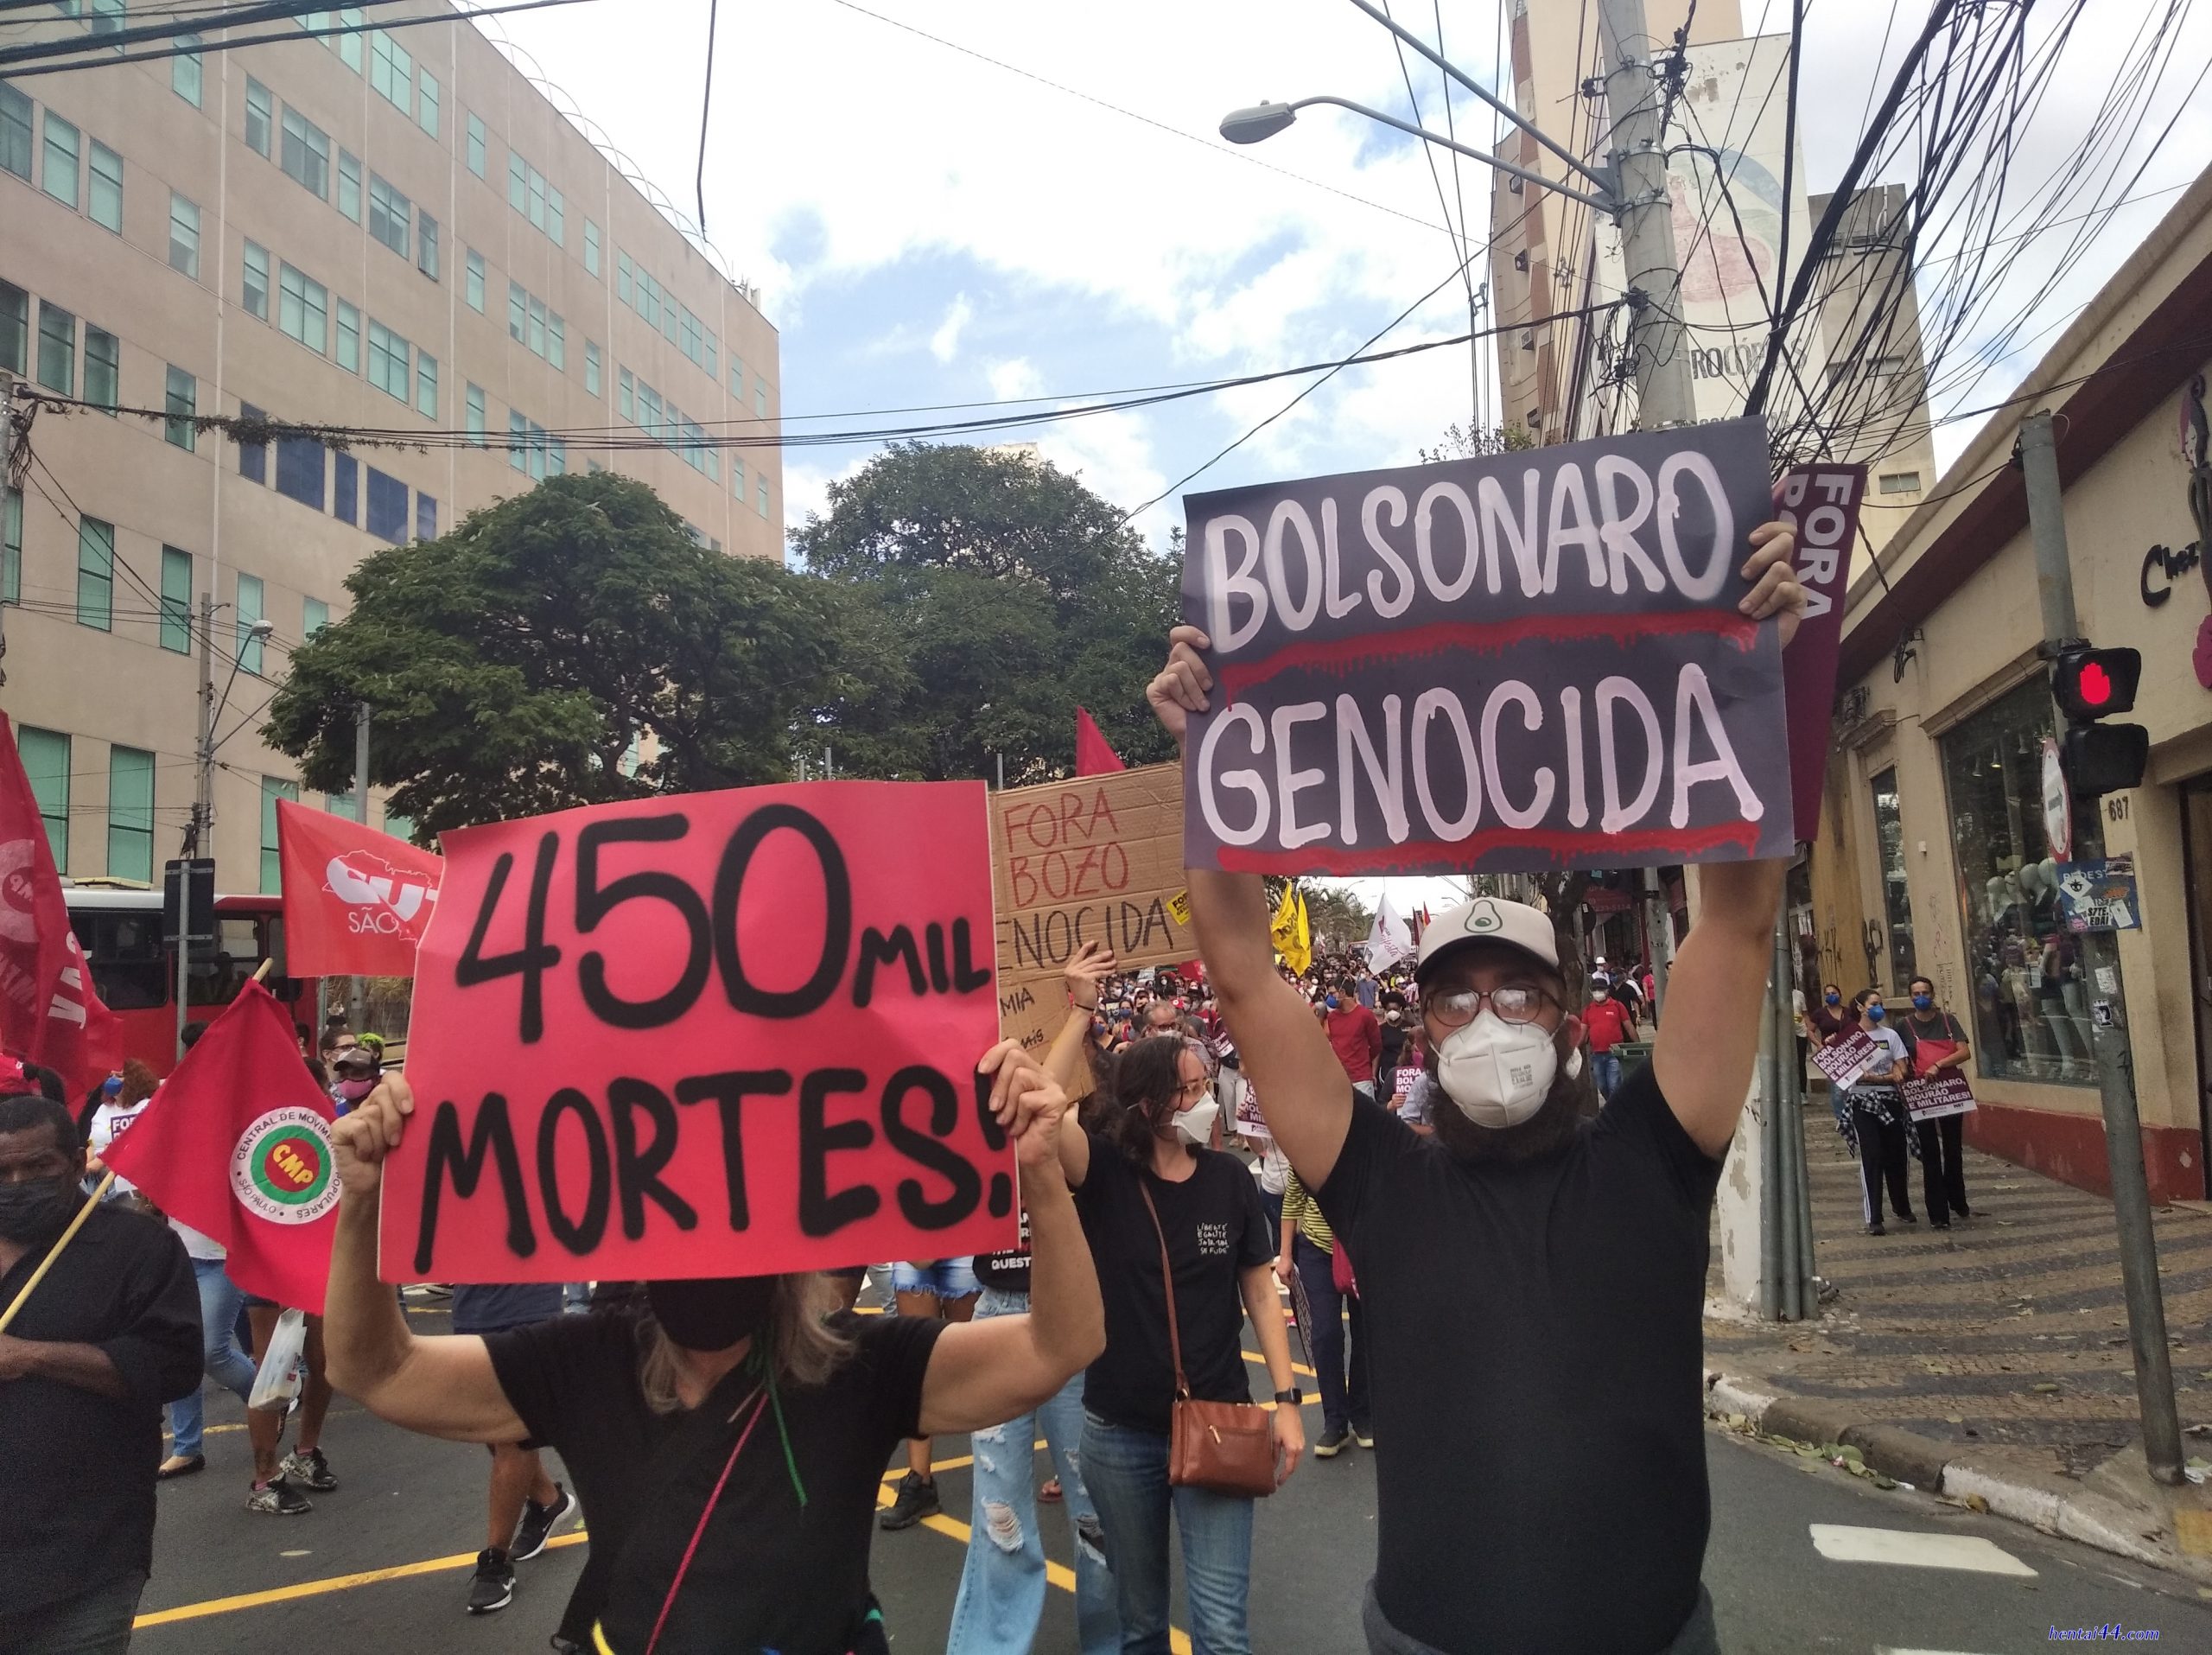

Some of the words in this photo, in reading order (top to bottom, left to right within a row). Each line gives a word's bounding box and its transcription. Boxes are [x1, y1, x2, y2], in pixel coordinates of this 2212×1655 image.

[1205, 450, 1733, 653] BOLSONARO
[1796, 474, 1855, 621] FORA
[1198, 662, 1765, 849] GENOCIDA
[1004, 786, 1120, 853] FORA
[2108, 796, 2129, 821] 687
[326, 857, 439, 922] CU
[1009, 841, 1129, 909] BOZO
[348, 907, 400, 934] SÃO
[455, 804, 852, 1044] 450
[852, 917, 992, 1008] MIL
[1811, 1045, 1834, 1064] FORA
[1818, 1031, 1866, 1070] BOLSONARO,
[1835, 1041, 1876, 1076] MILITARES!
[1396, 1067, 1422, 1077] FORA
[1903, 1078, 1967, 1097] BOLSONARO,
[1916, 1092, 1972, 1107] MILITARES!
[237, 1117, 277, 1160] CENTRAL
[279, 1111, 296, 1122] DE
[272, 1143, 314, 1184] CMP
[414, 1064, 1012, 1275] MORTES!
[251, 1193, 276, 1213] PAULO
[991, 1257, 1032, 1270] QUEST
